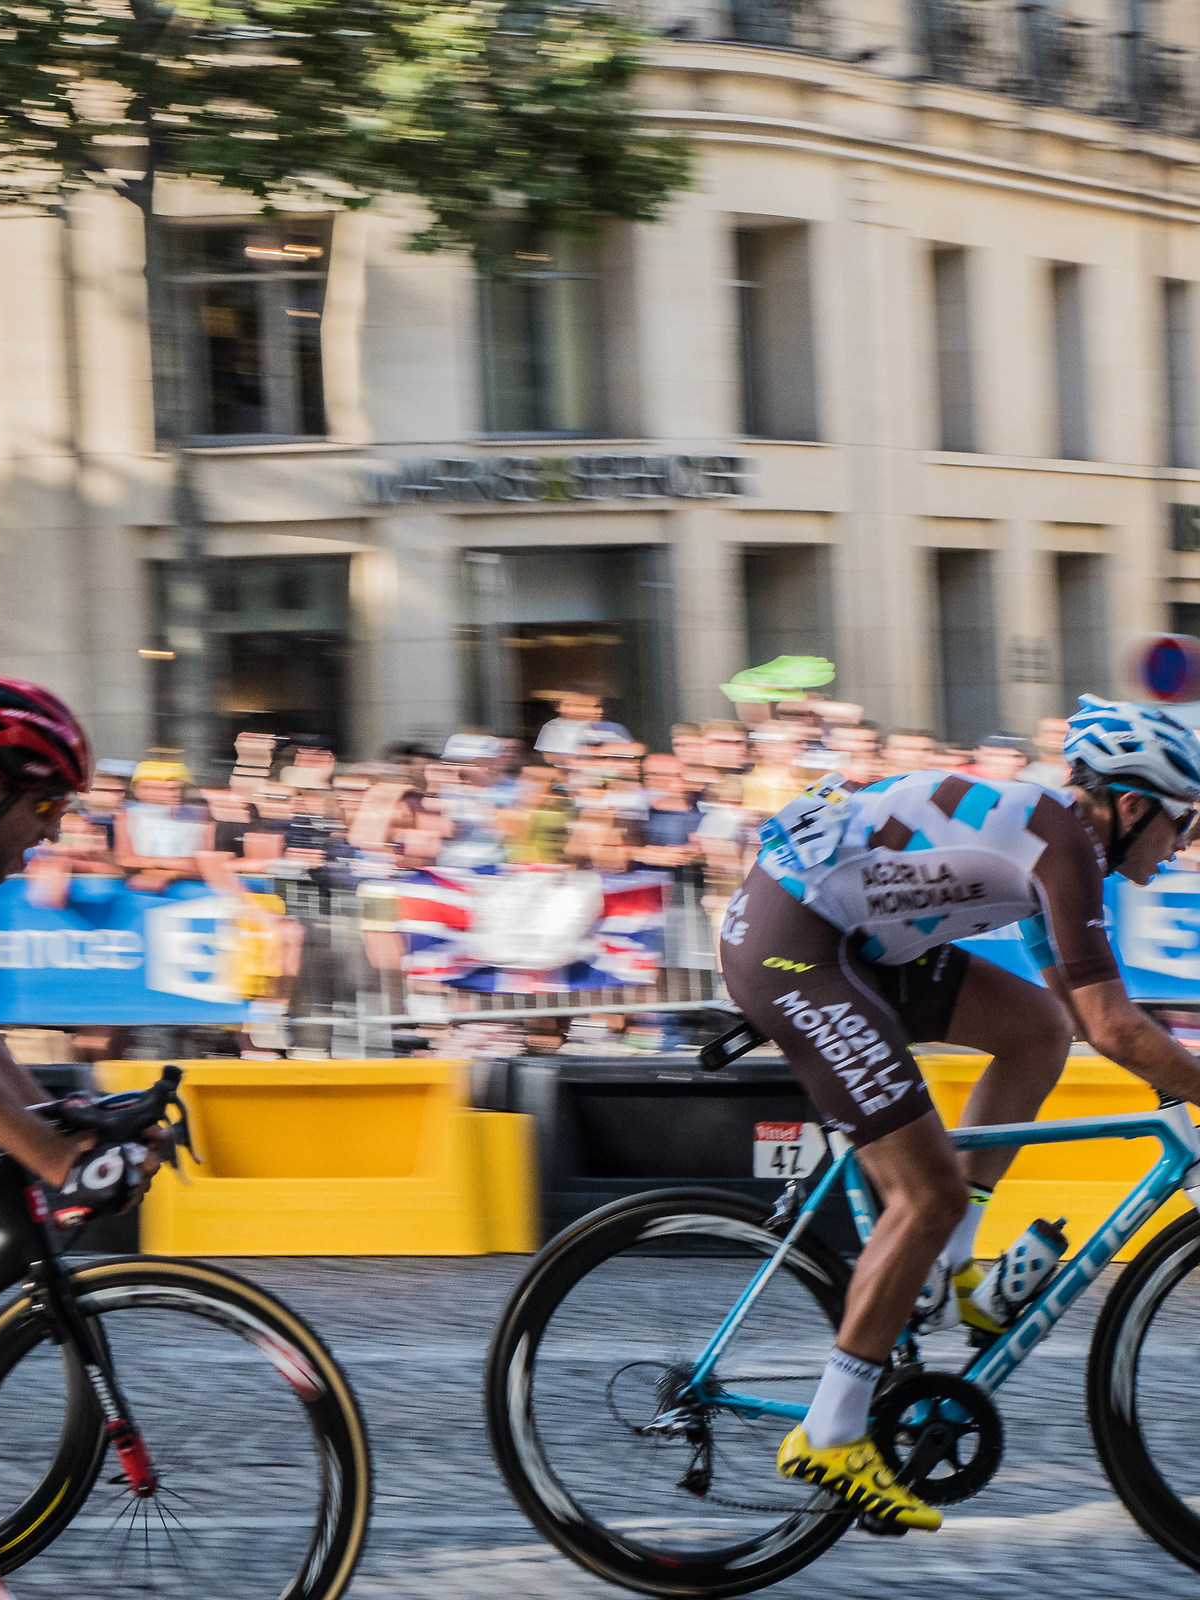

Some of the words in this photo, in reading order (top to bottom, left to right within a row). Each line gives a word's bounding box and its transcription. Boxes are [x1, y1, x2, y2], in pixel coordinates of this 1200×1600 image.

[772, 989, 893, 1117] MONDIALE
[818, 1001, 894, 1068] AG2R
[873, 1060, 914, 1103] LA
[771, 1145, 804, 1176] 47
[972, 1186, 1159, 1394] FOCUS
